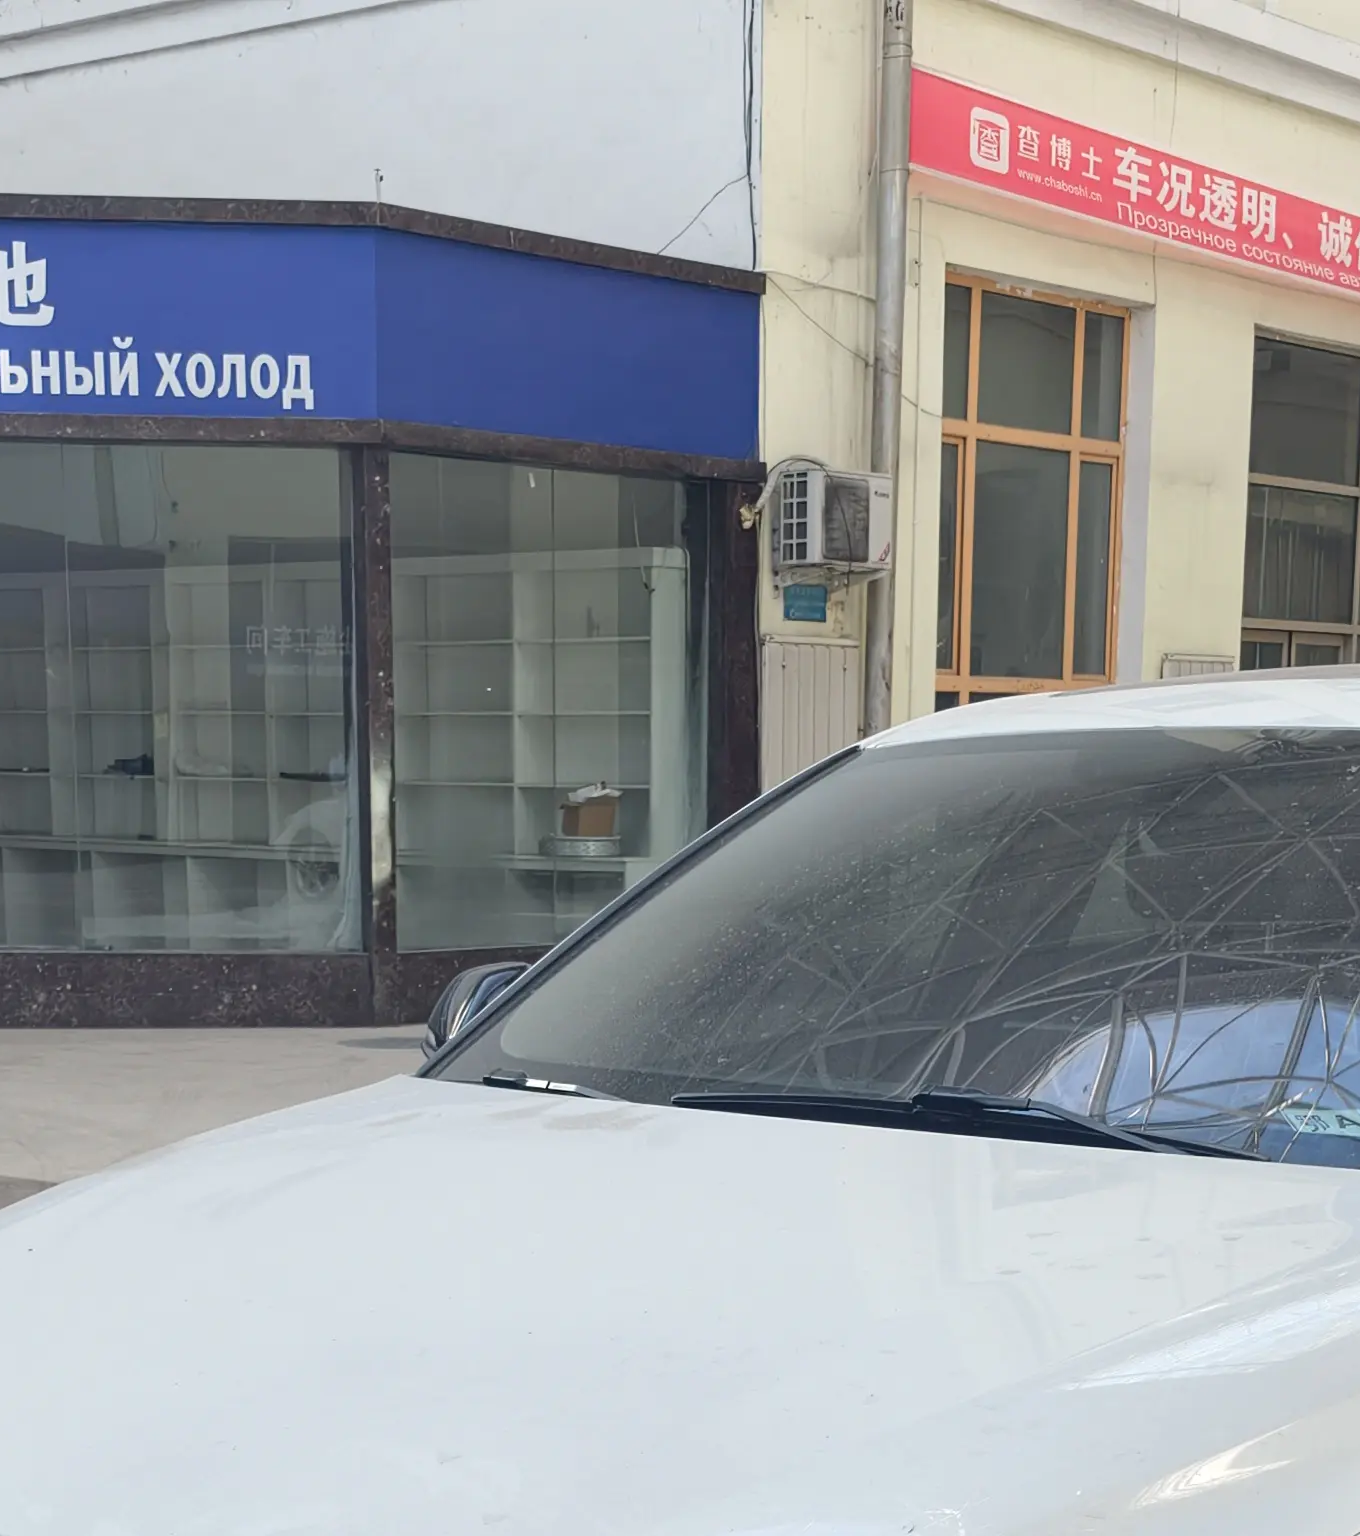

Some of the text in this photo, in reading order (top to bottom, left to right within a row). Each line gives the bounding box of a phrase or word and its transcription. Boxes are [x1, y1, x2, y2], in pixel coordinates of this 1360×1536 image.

[1017, 125, 1103, 182] 查博士
[1017, 167, 1103, 203] www.chaboshi.cn
[1116, 202, 1237, 252] Прозрачное
[1243, 242, 1335, 280] состояние
[155, 353, 314, 410] холод
